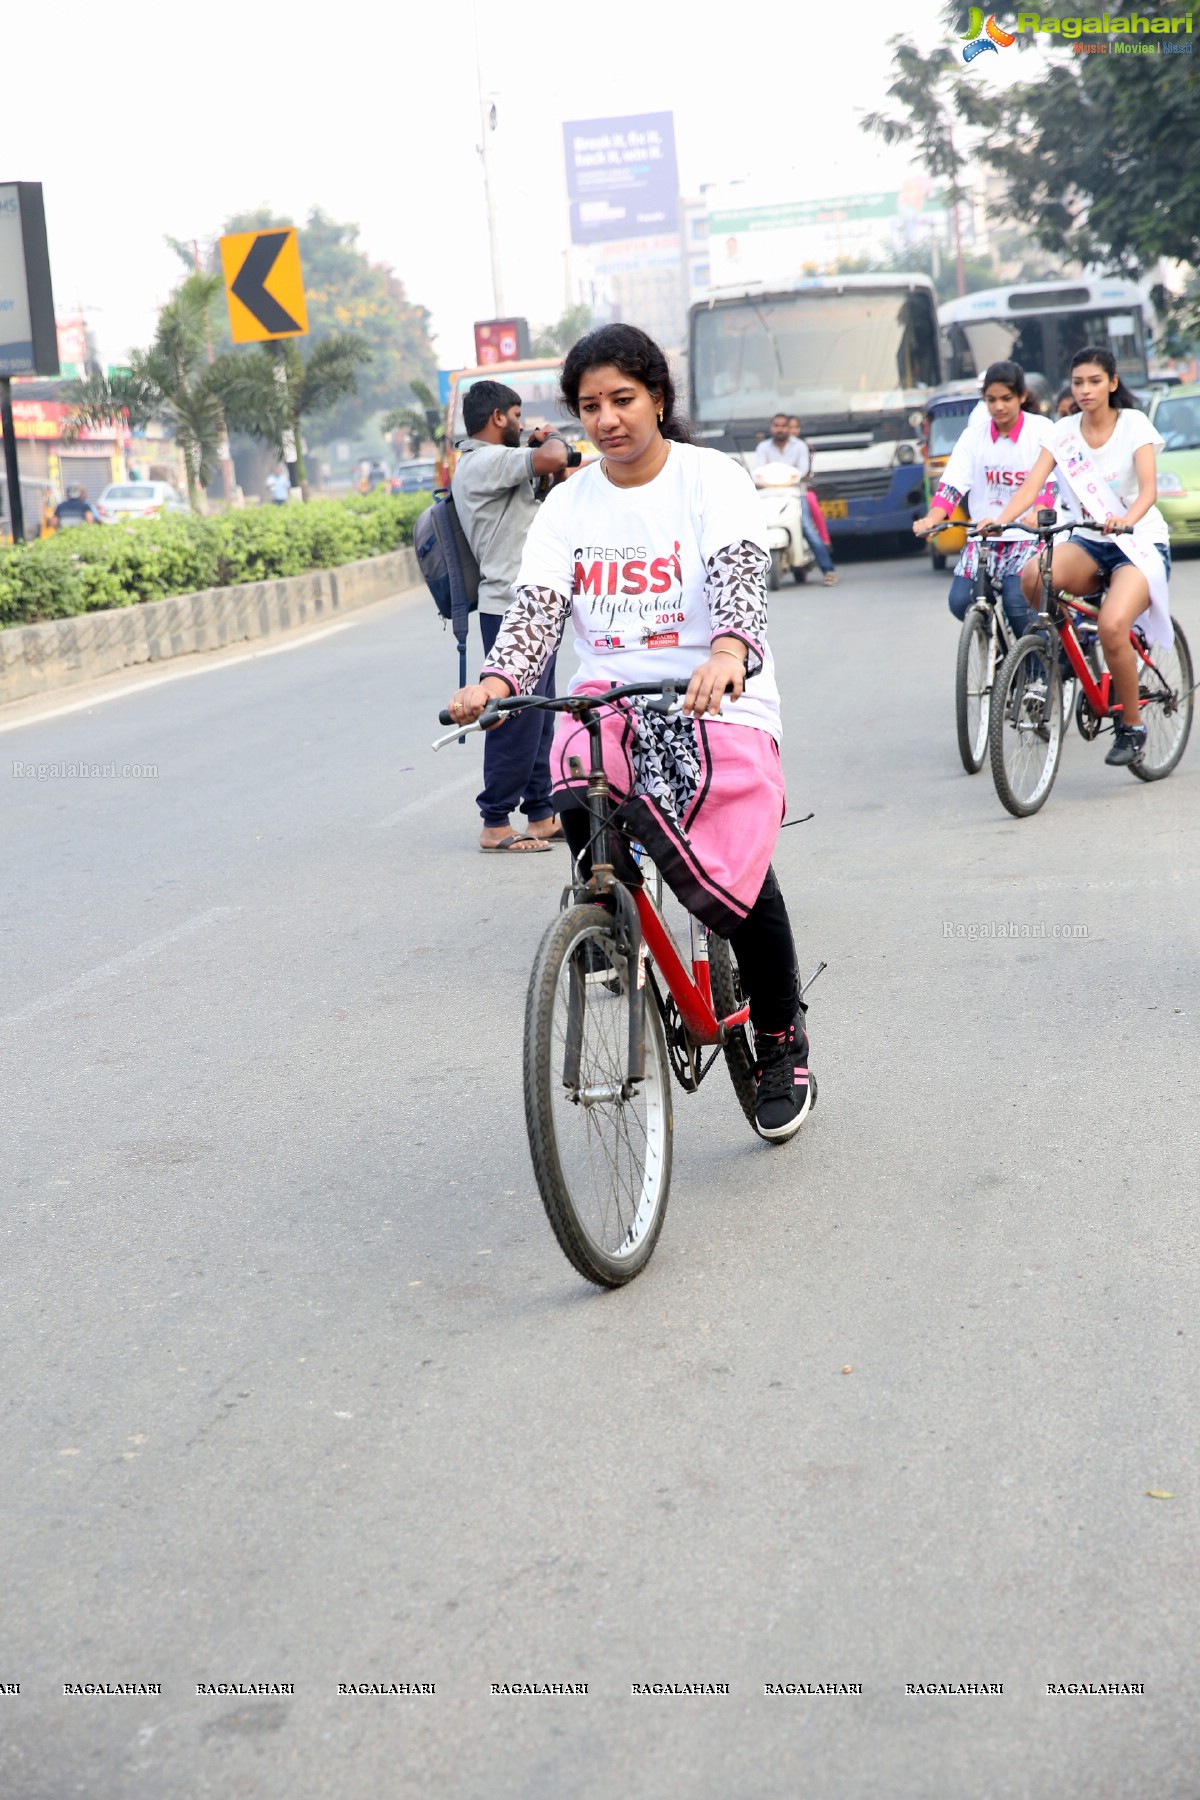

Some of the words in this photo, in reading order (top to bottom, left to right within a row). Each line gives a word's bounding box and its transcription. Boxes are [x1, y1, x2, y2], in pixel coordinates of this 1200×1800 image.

[985, 471, 1026, 486] MISS
[584, 546, 647, 561] TRENDS
[573, 557, 673, 596] MISS
[589, 592, 685, 630] Hyderabad
[655, 612, 685, 625] 2018
